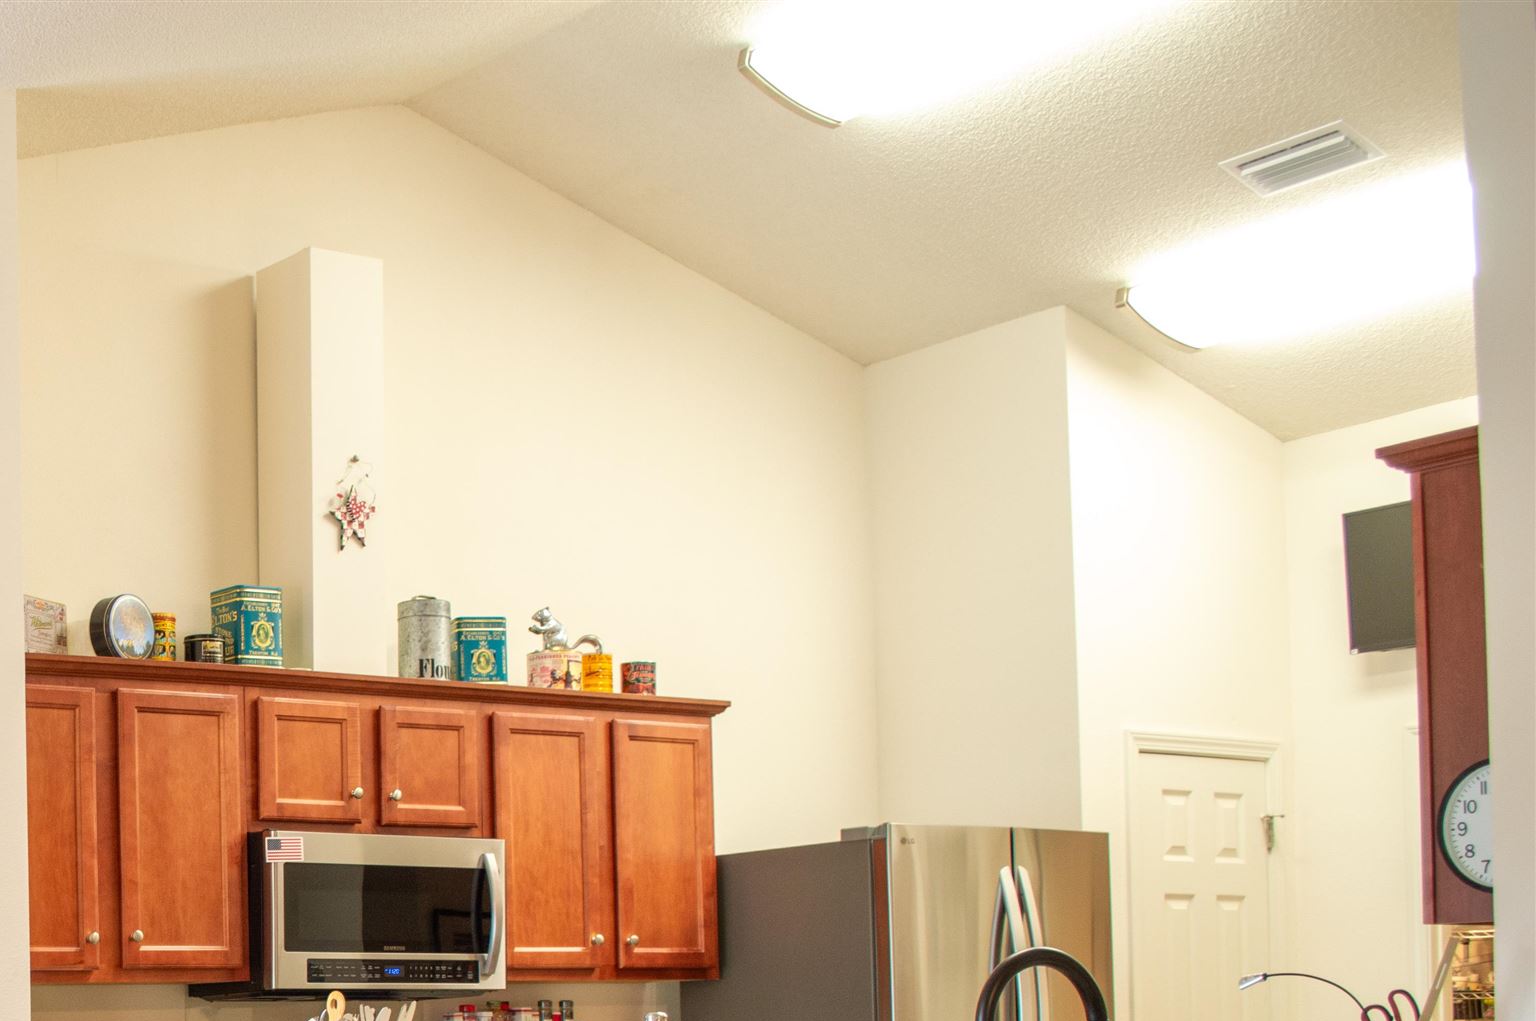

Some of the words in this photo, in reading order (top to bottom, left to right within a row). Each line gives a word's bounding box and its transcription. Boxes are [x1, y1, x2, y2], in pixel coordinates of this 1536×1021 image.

[1480, 780, 1488, 795] 11
[1463, 799, 1478, 814] 10
[1457, 821, 1468, 837] 9
[1464, 843, 1476, 859] 8
[1481, 859, 1492, 874] 7
